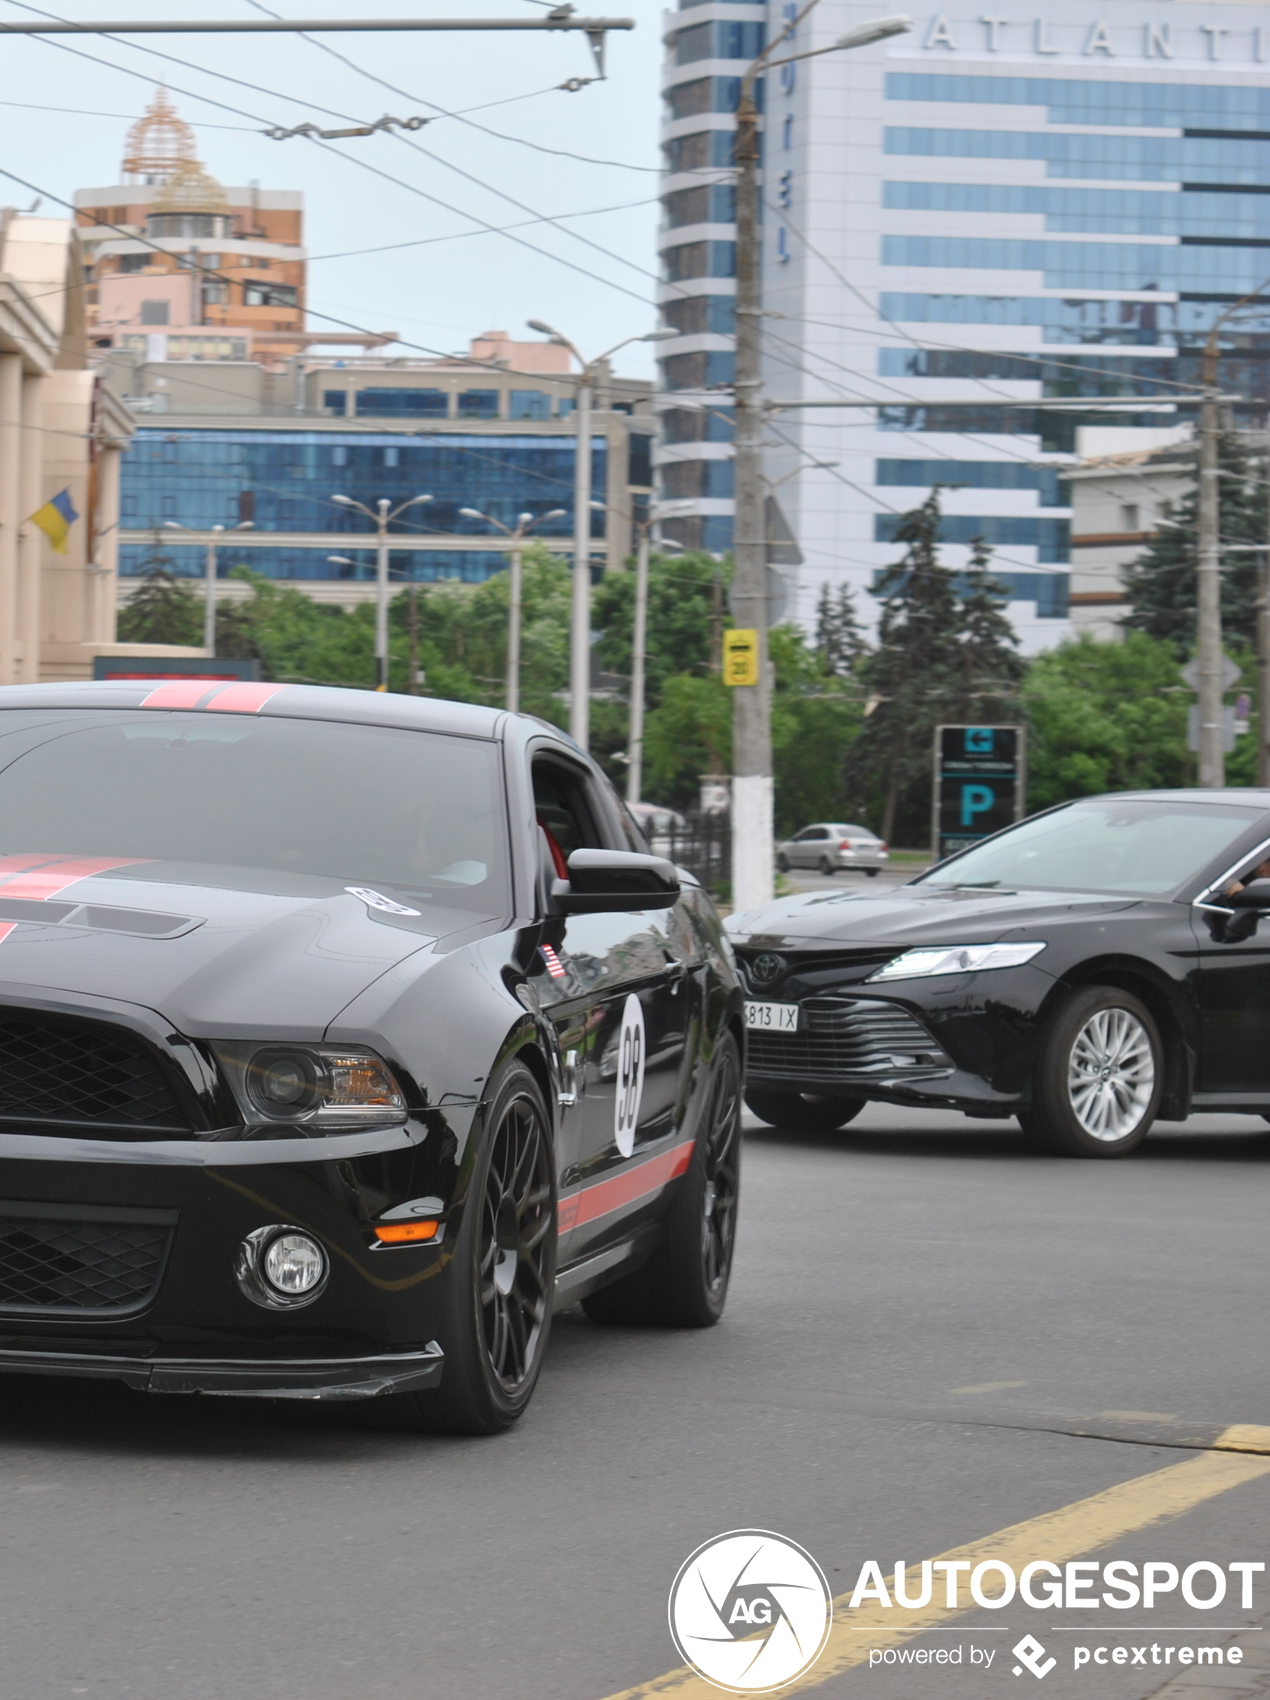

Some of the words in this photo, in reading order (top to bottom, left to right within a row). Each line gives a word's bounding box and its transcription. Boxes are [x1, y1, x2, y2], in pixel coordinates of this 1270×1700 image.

[923, 13, 1266, 63] ATLANTI
[960, 784, 995, 826] P
[779, 1008, 796, 1028] IX
[618, 1023, 641, 1132] 98
